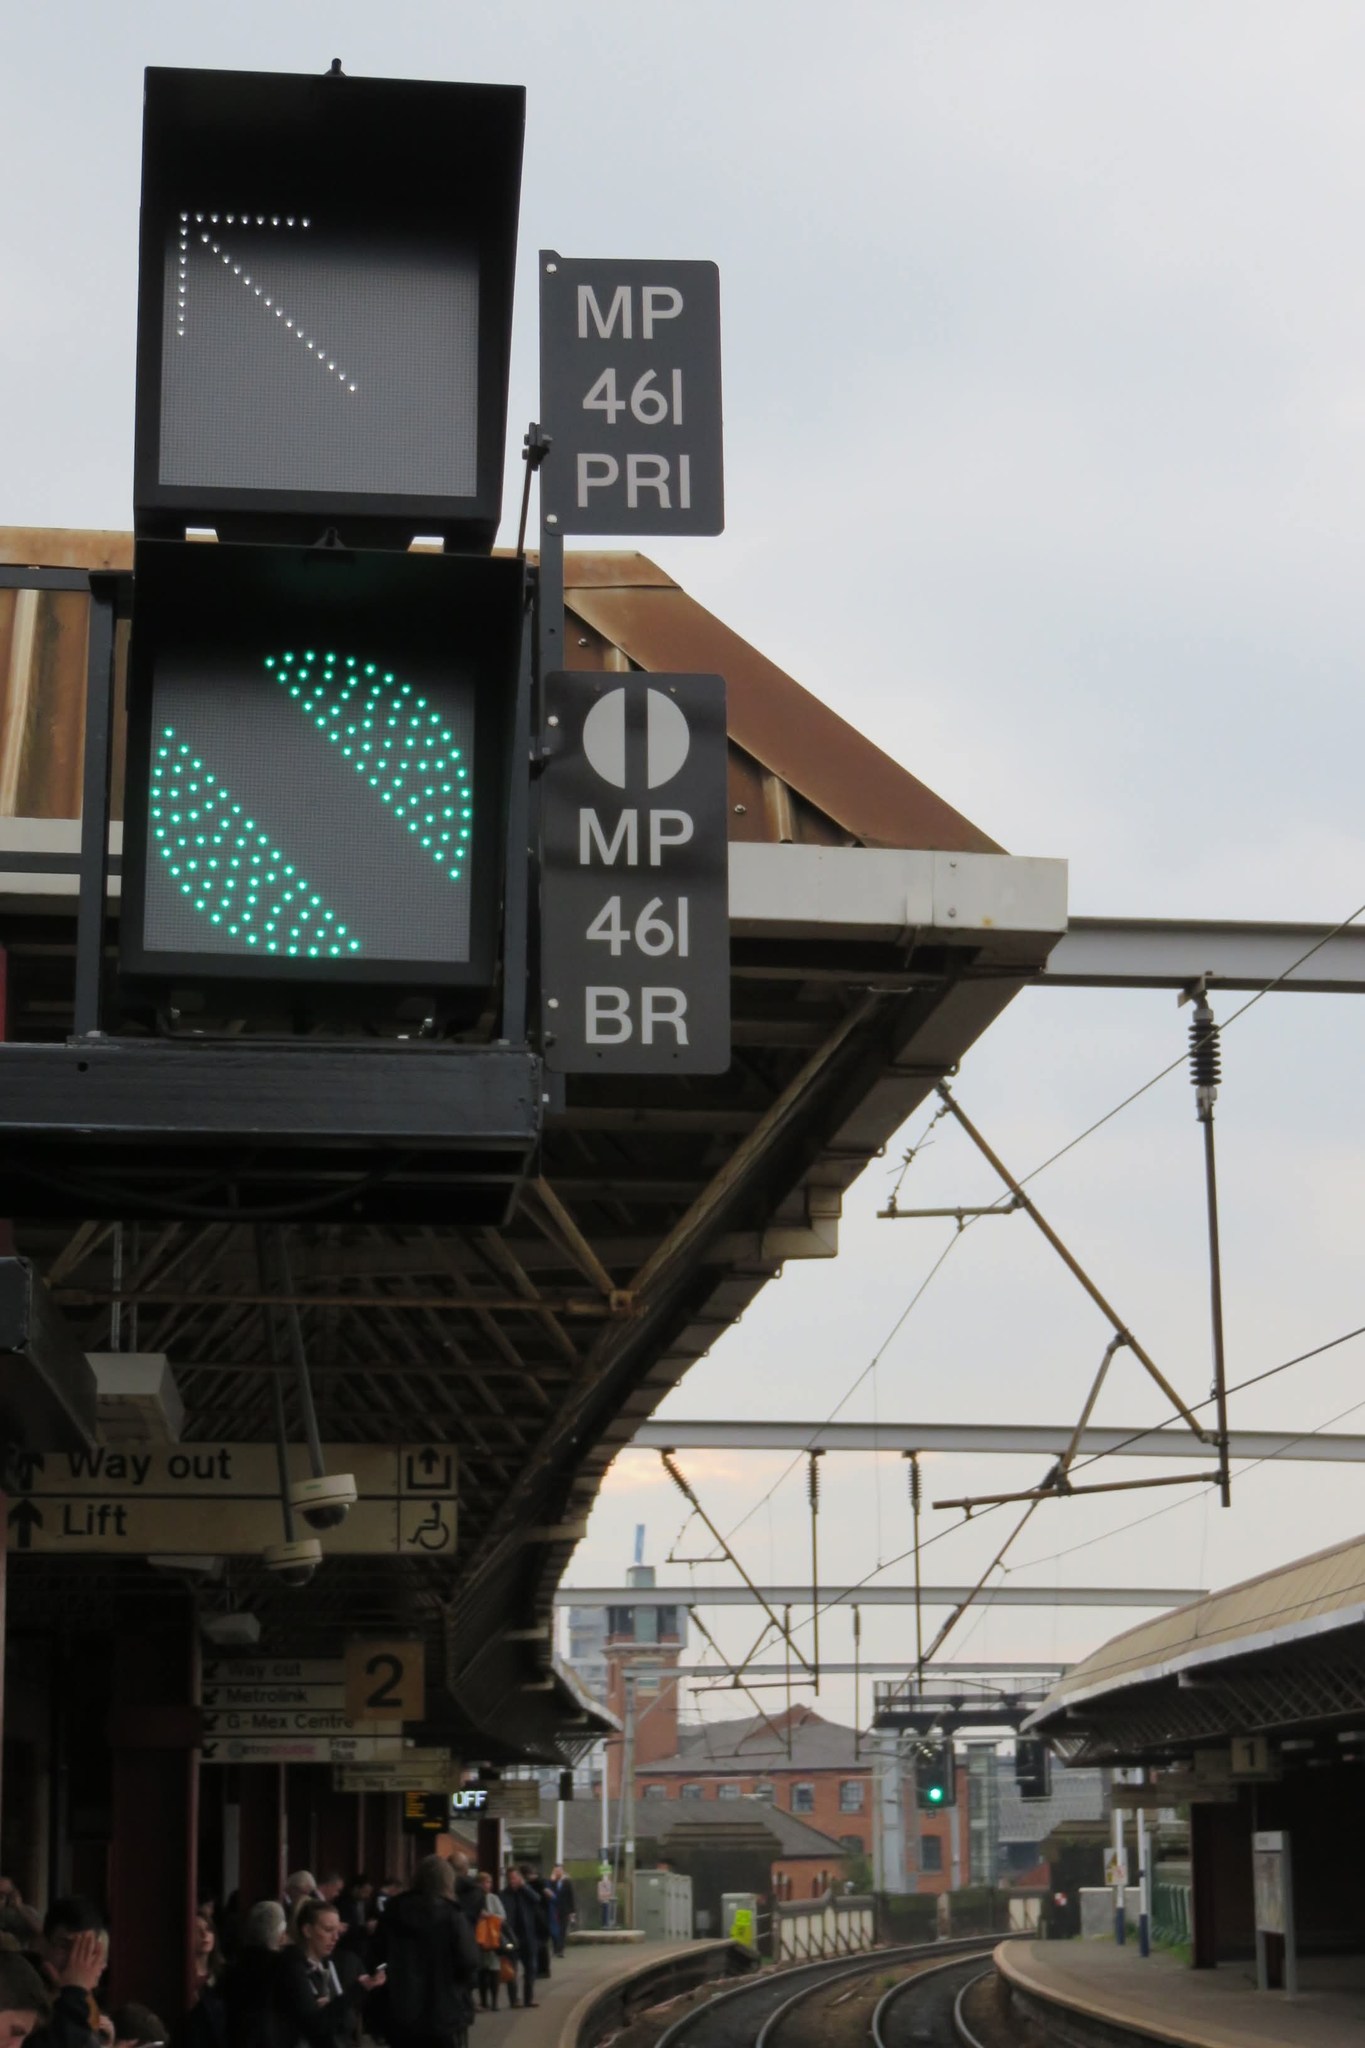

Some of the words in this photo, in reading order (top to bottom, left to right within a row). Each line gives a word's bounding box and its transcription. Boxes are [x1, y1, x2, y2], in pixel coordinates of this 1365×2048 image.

[577, 284, 684, 340] MP
[582, 367, 683, 426] 461
[577, 452, 691, 509] PRI
[579, 808, 695, 866] MP
[585, 896, 689, 958] 461
[585, 986, 689, 1045] BR
[68, 1447, 151, 1485] Way
[168, 1449, 231, 1479] out
[64, 1504, 126, 1535] Lift
[227, 1661, 264, 1680] Way
[274, 1662, 302, 1677] out
[227, 1688, 307, 1703] Metrolink
[365, 1653, 404, 1708] 2
[294, 1713, 353, 1729] Centre
[452, 1790, 489, 1809] OFF
